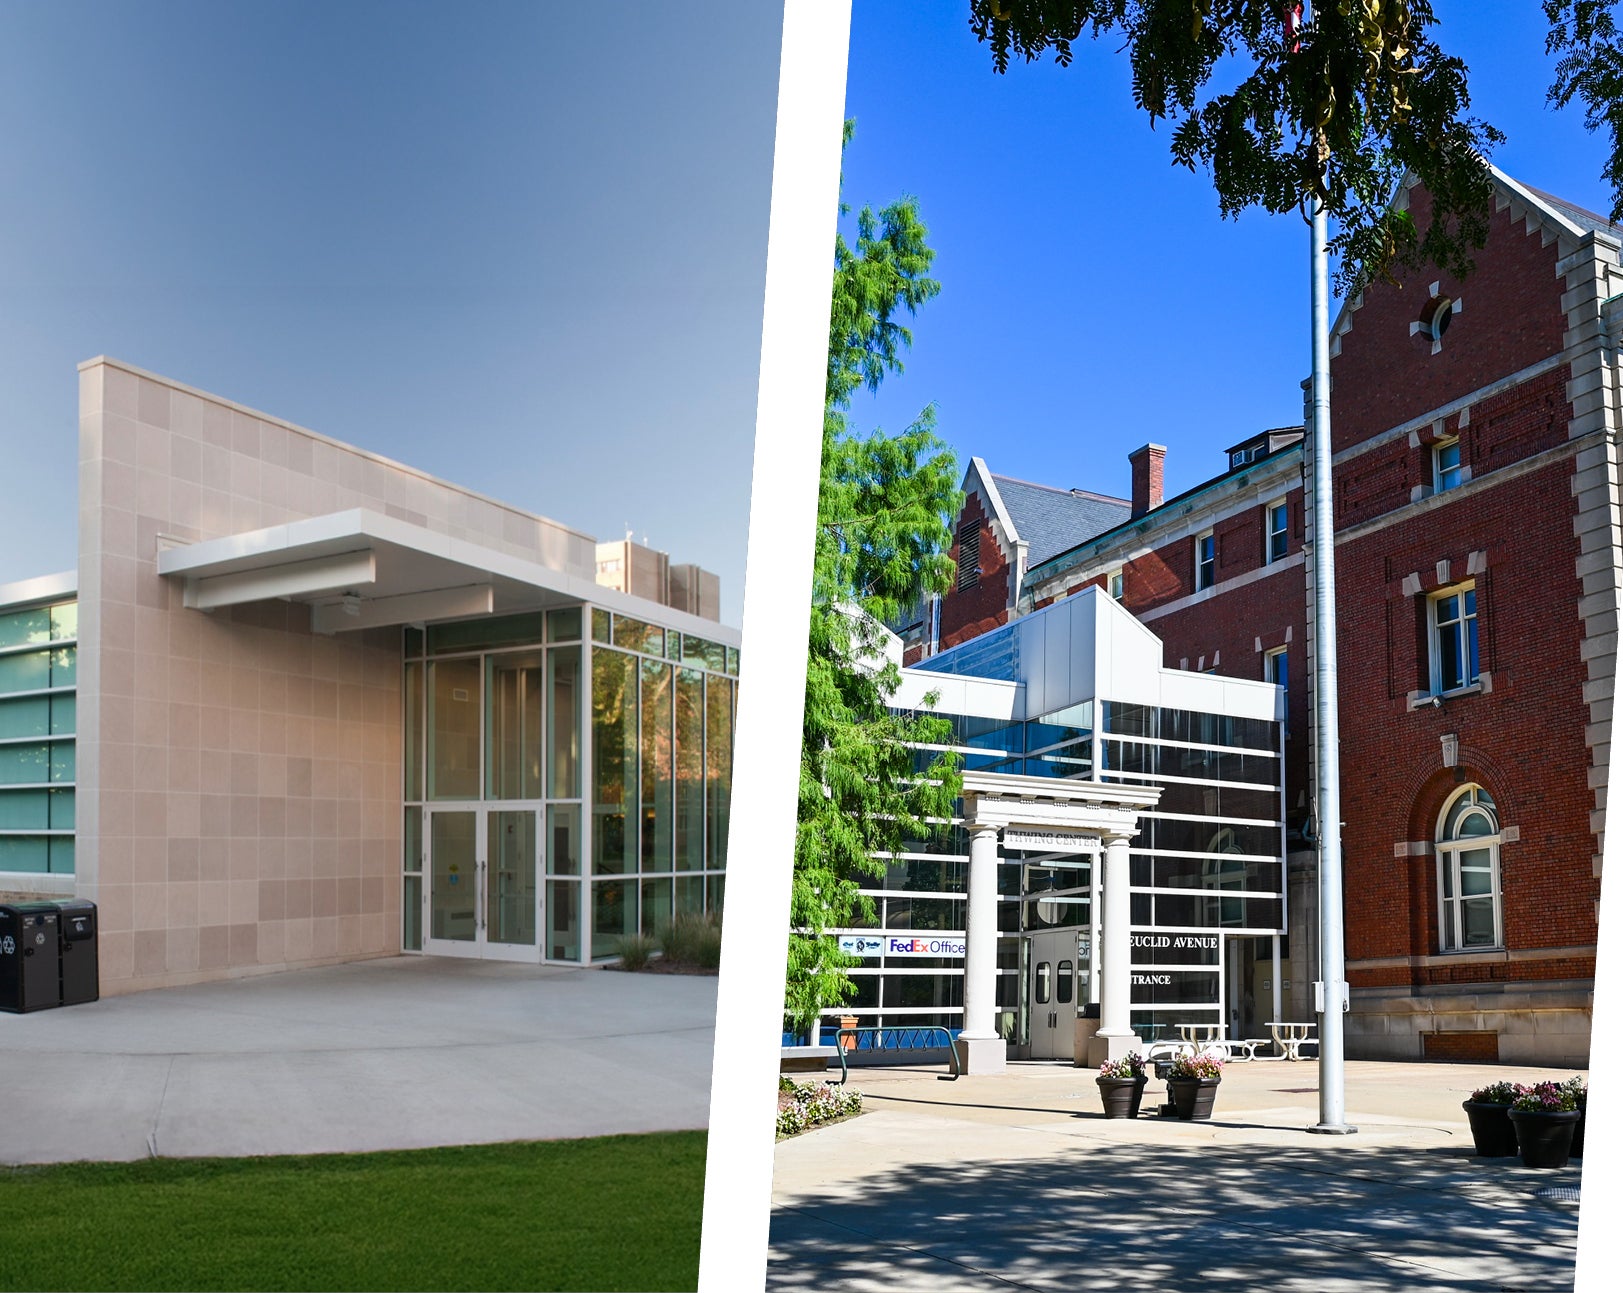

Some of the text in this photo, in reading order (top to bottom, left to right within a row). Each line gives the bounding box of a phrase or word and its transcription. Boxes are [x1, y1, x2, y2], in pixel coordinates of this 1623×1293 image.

[1055, 833, 1098, 848] CENTER
[890, 939, 929, 953] FedEx
[929, 940, 966, 954] Office
[1130, 936, 1217, 949] EUCLID AVENUE
[1130, 974, 1171, 985] TRANCE
